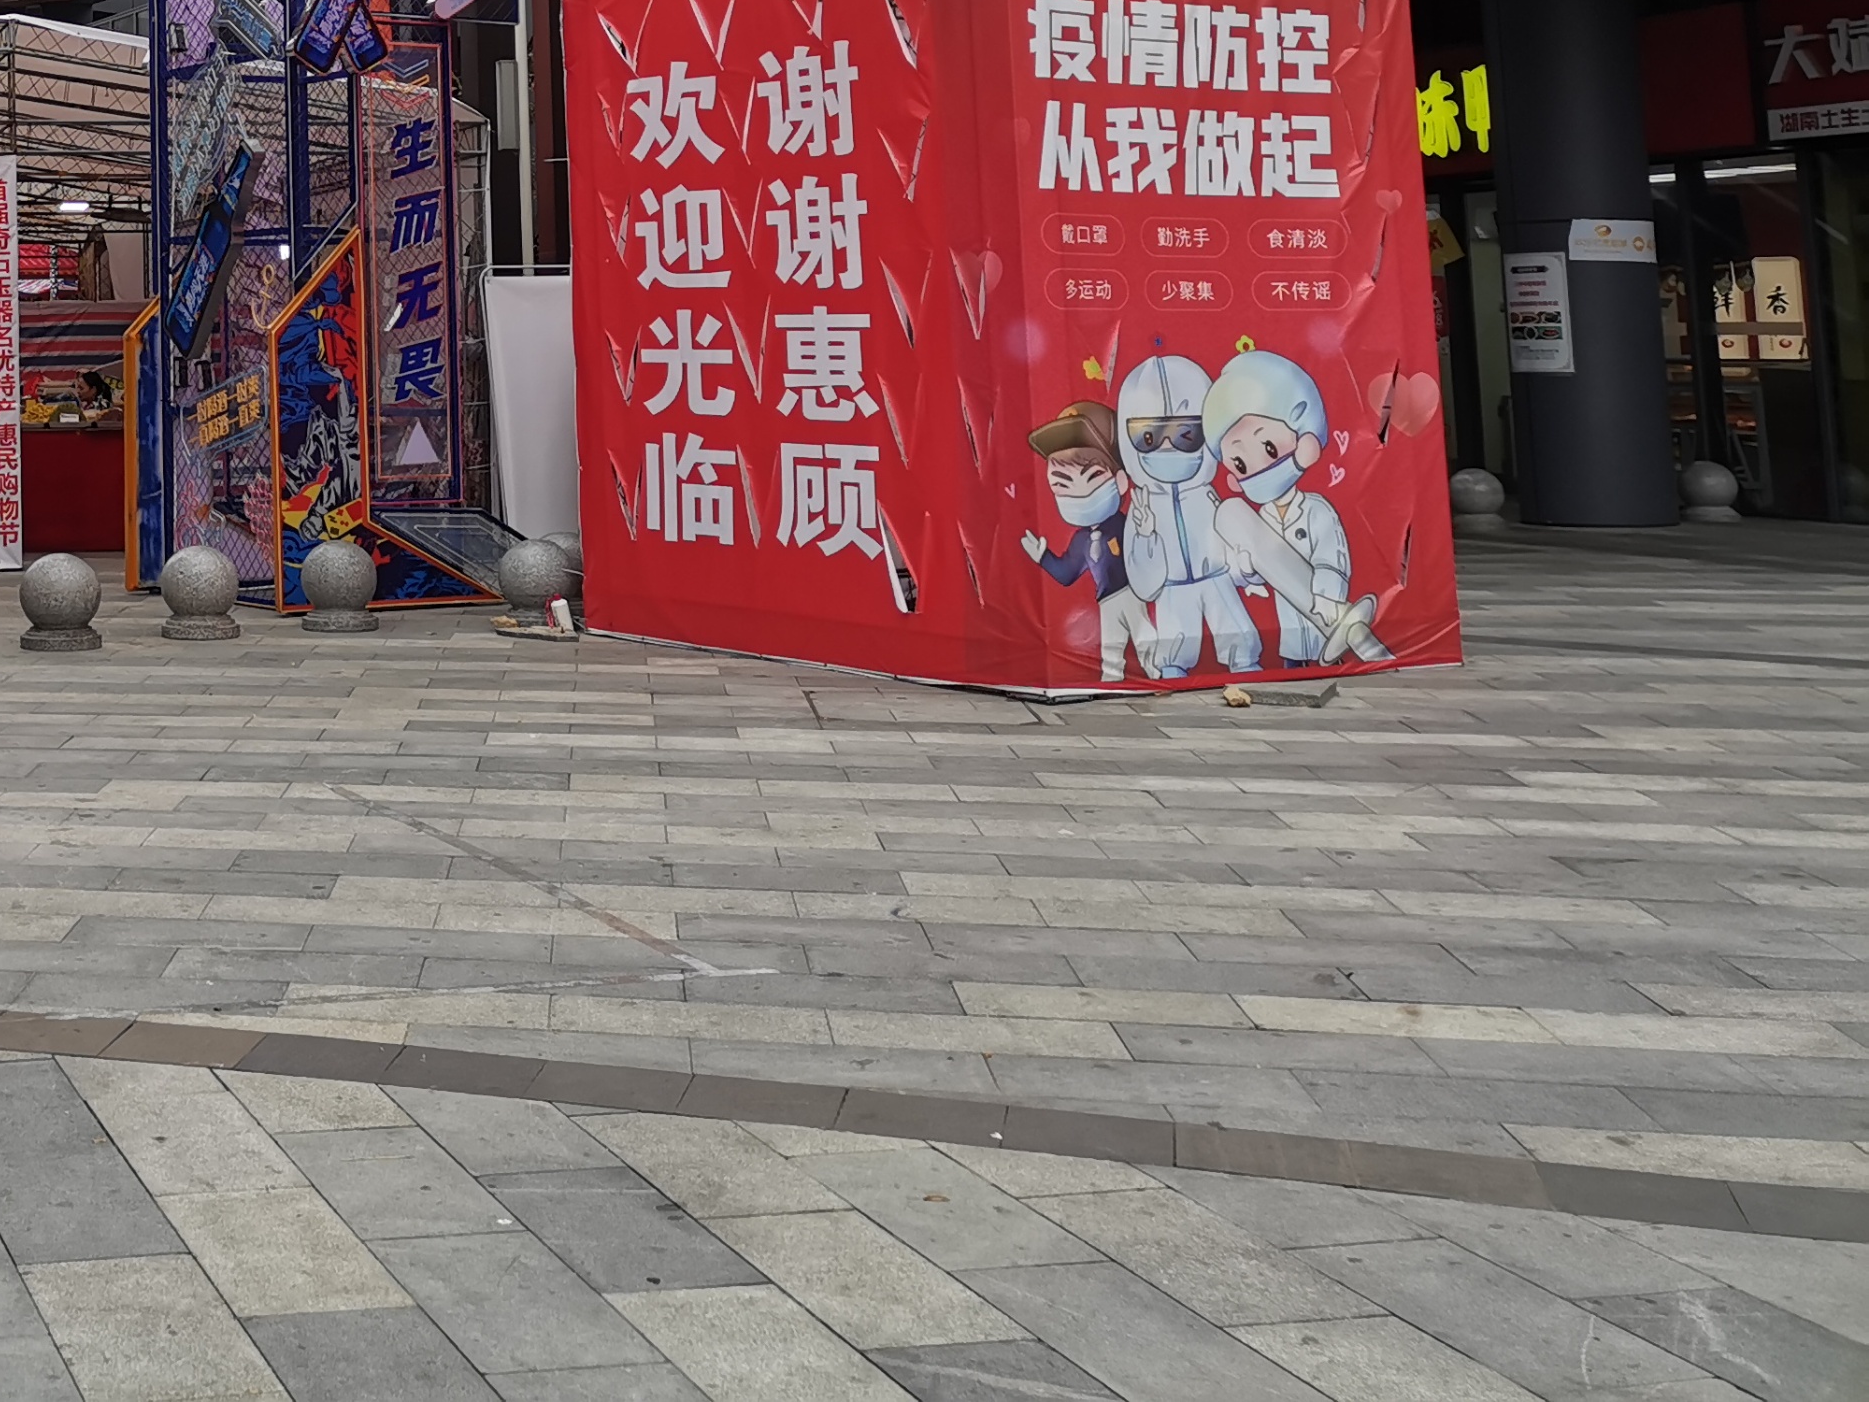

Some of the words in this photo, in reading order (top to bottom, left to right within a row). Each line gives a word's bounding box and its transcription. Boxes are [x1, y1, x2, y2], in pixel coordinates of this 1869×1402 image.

[1038, 100, 1340, 198] 从我做起
[1060, 223, 1109, 246] 戴口罩
[1156, 226, 1210, 248] 勤洗手
[1266, 228, 1328, 250] 食清淡
[389, 118, 445, 402] 生而无畏
[756, 39, 885, 560] 谢谢惠顾
[1064, 279, 1113, 301] 多运动
[1160, 280, 1215, 302] 少聚集
[1270, 280, 1332, 302] 不传谣
[627, 61, 737, 546] 欢迎光临
